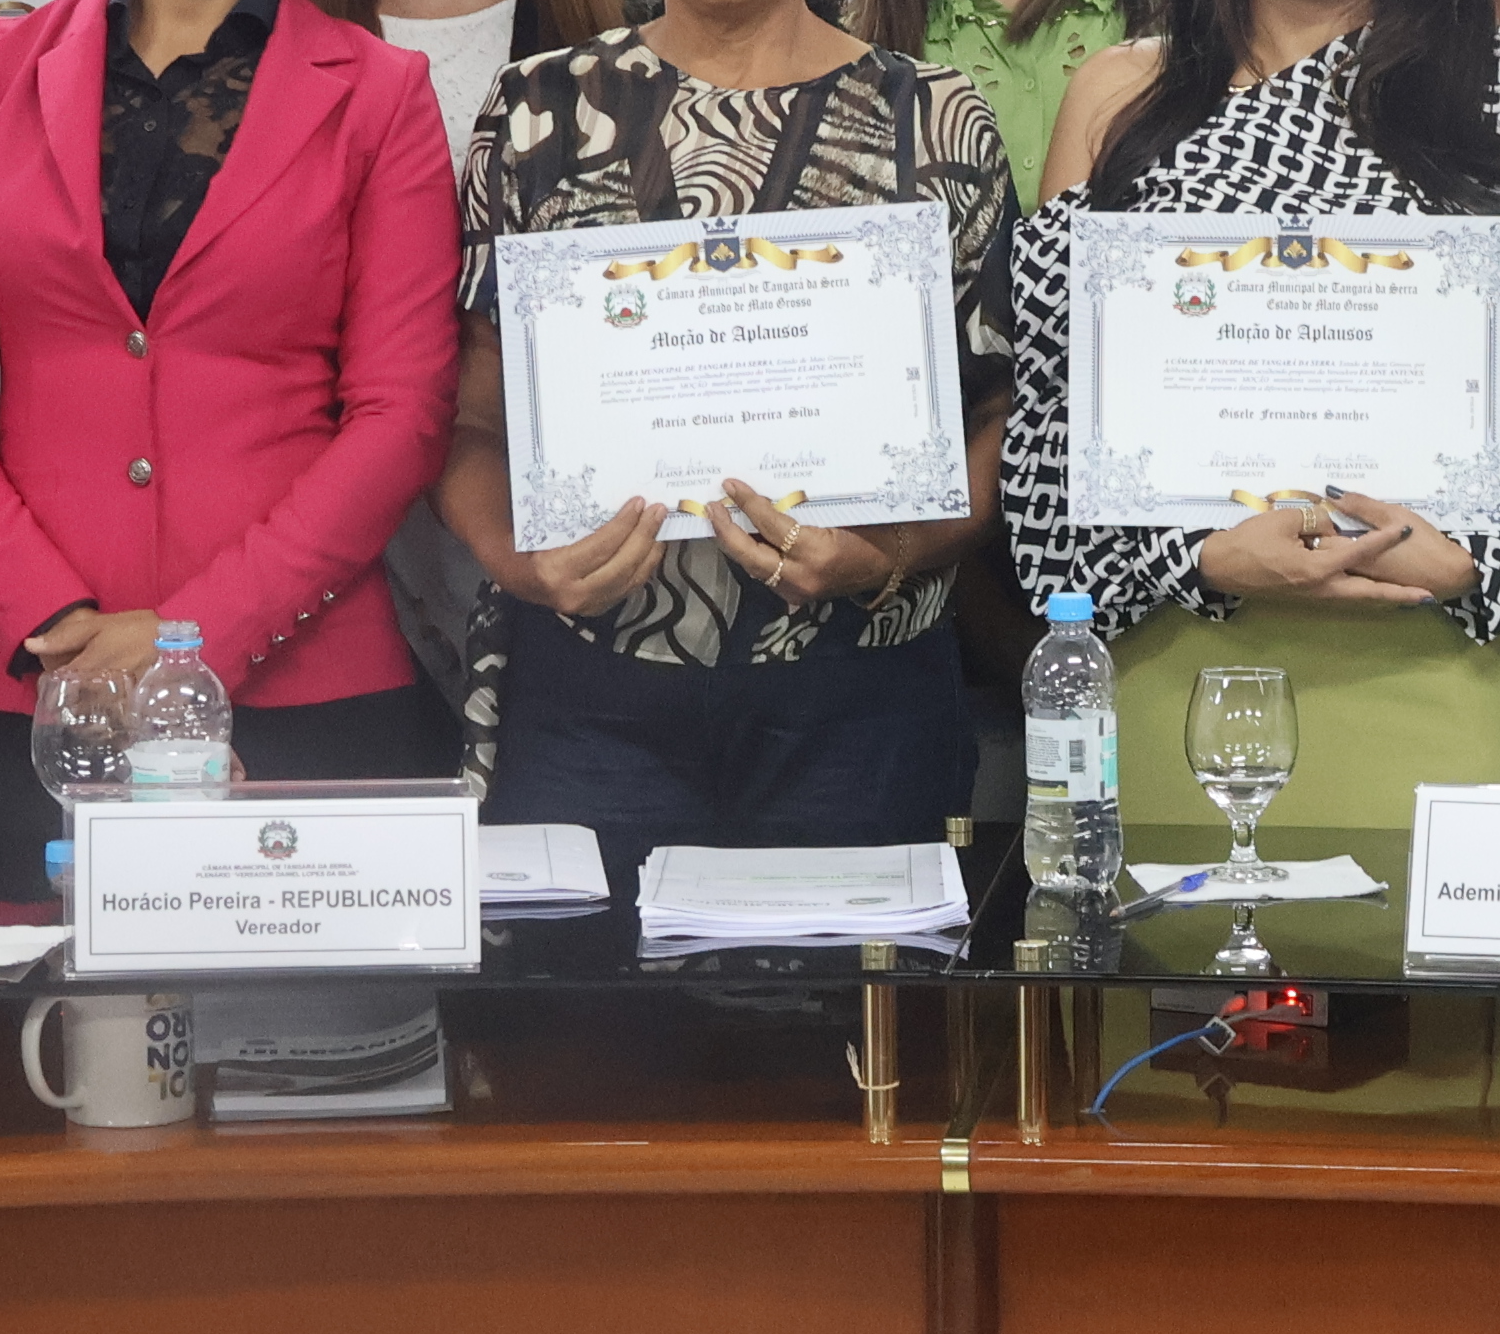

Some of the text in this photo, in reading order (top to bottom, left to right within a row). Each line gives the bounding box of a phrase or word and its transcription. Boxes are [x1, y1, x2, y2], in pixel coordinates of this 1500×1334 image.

[1227, 281, 1418, 297] Câmara Municipal de Tangará da Serra
[1267, 298, 1379, 313] Estado de Mato Grosso
[651, 323, 809, 351] Moção de Aplausos
[1216, 323, 1374, 344] Moção de Aplausos
[651, 406, 820, 430] Maria Edlucia Pereira Silva
[1218, 408, 1370, 422] Gisele Fernandes Sanchez
[102, 891, 182, 912] Horácio
[190, 891, 261, 910] Pereira
[281, 887, 452, 909] REPUBLICANOS
[235, 919, 321, 935] Vereador
